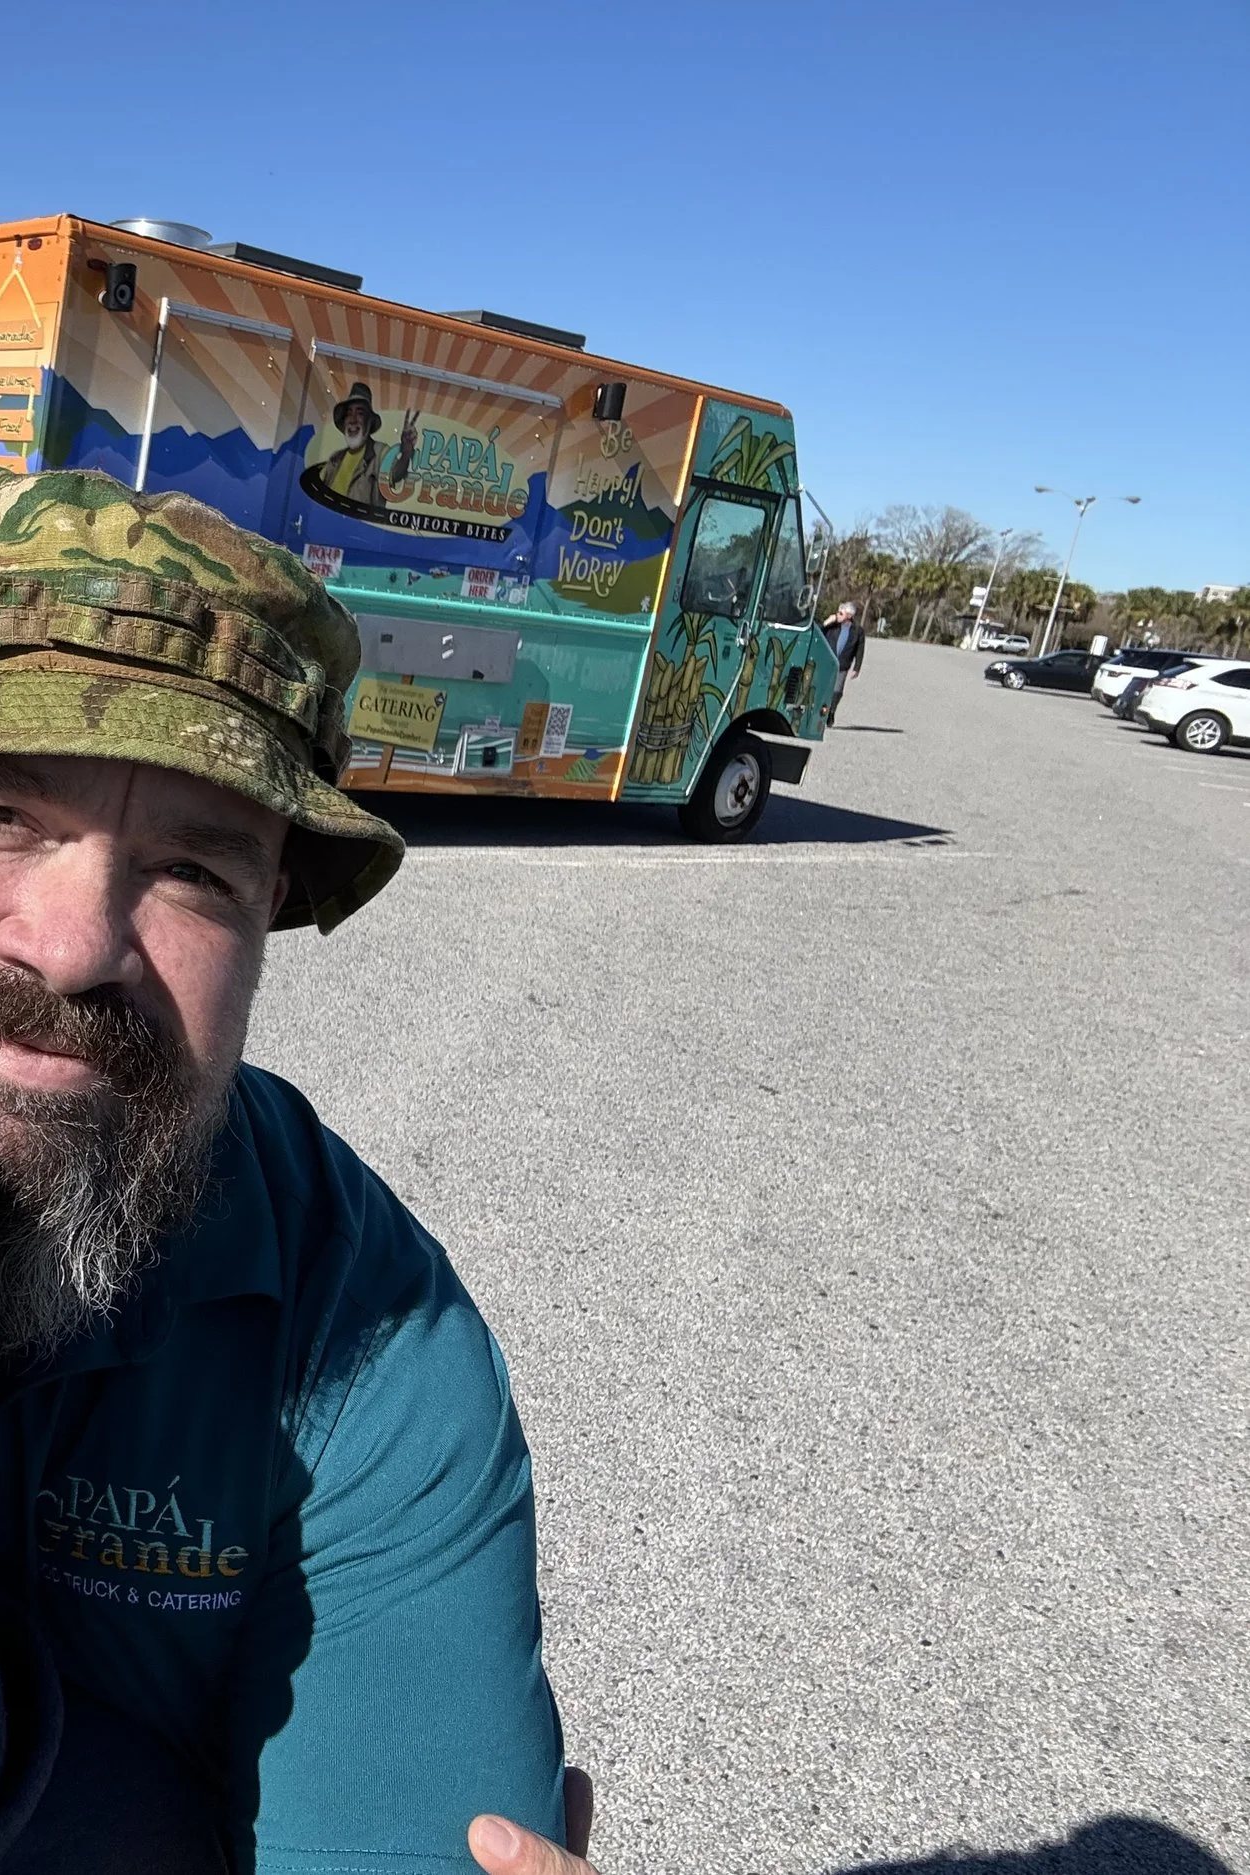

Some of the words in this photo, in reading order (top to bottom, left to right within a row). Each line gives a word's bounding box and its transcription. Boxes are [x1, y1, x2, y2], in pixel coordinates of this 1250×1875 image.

[419, 425, 501, 482] PAPÁ
[600, 420, 634, 458] Be
[378, 442, 529, 520] Grande
[574, 452, 645, 508] Happy!
[389, 511, 460, 535] COMFORT
[466, 525, 506, 542] BITES
[570, 510, 625, 545] Don't
[468, 569, 496, 585] ORDER
[468, 585, 490, 598] HERE
[359, 695, 438, 723] CATERING
[66, 1475, 194, 1539] PAPÁ
[65, 1571, 121, 1602] TRUCK
[127, 1586, 140, 1604] &
[148, 1590, 242, 1611] CATERING
